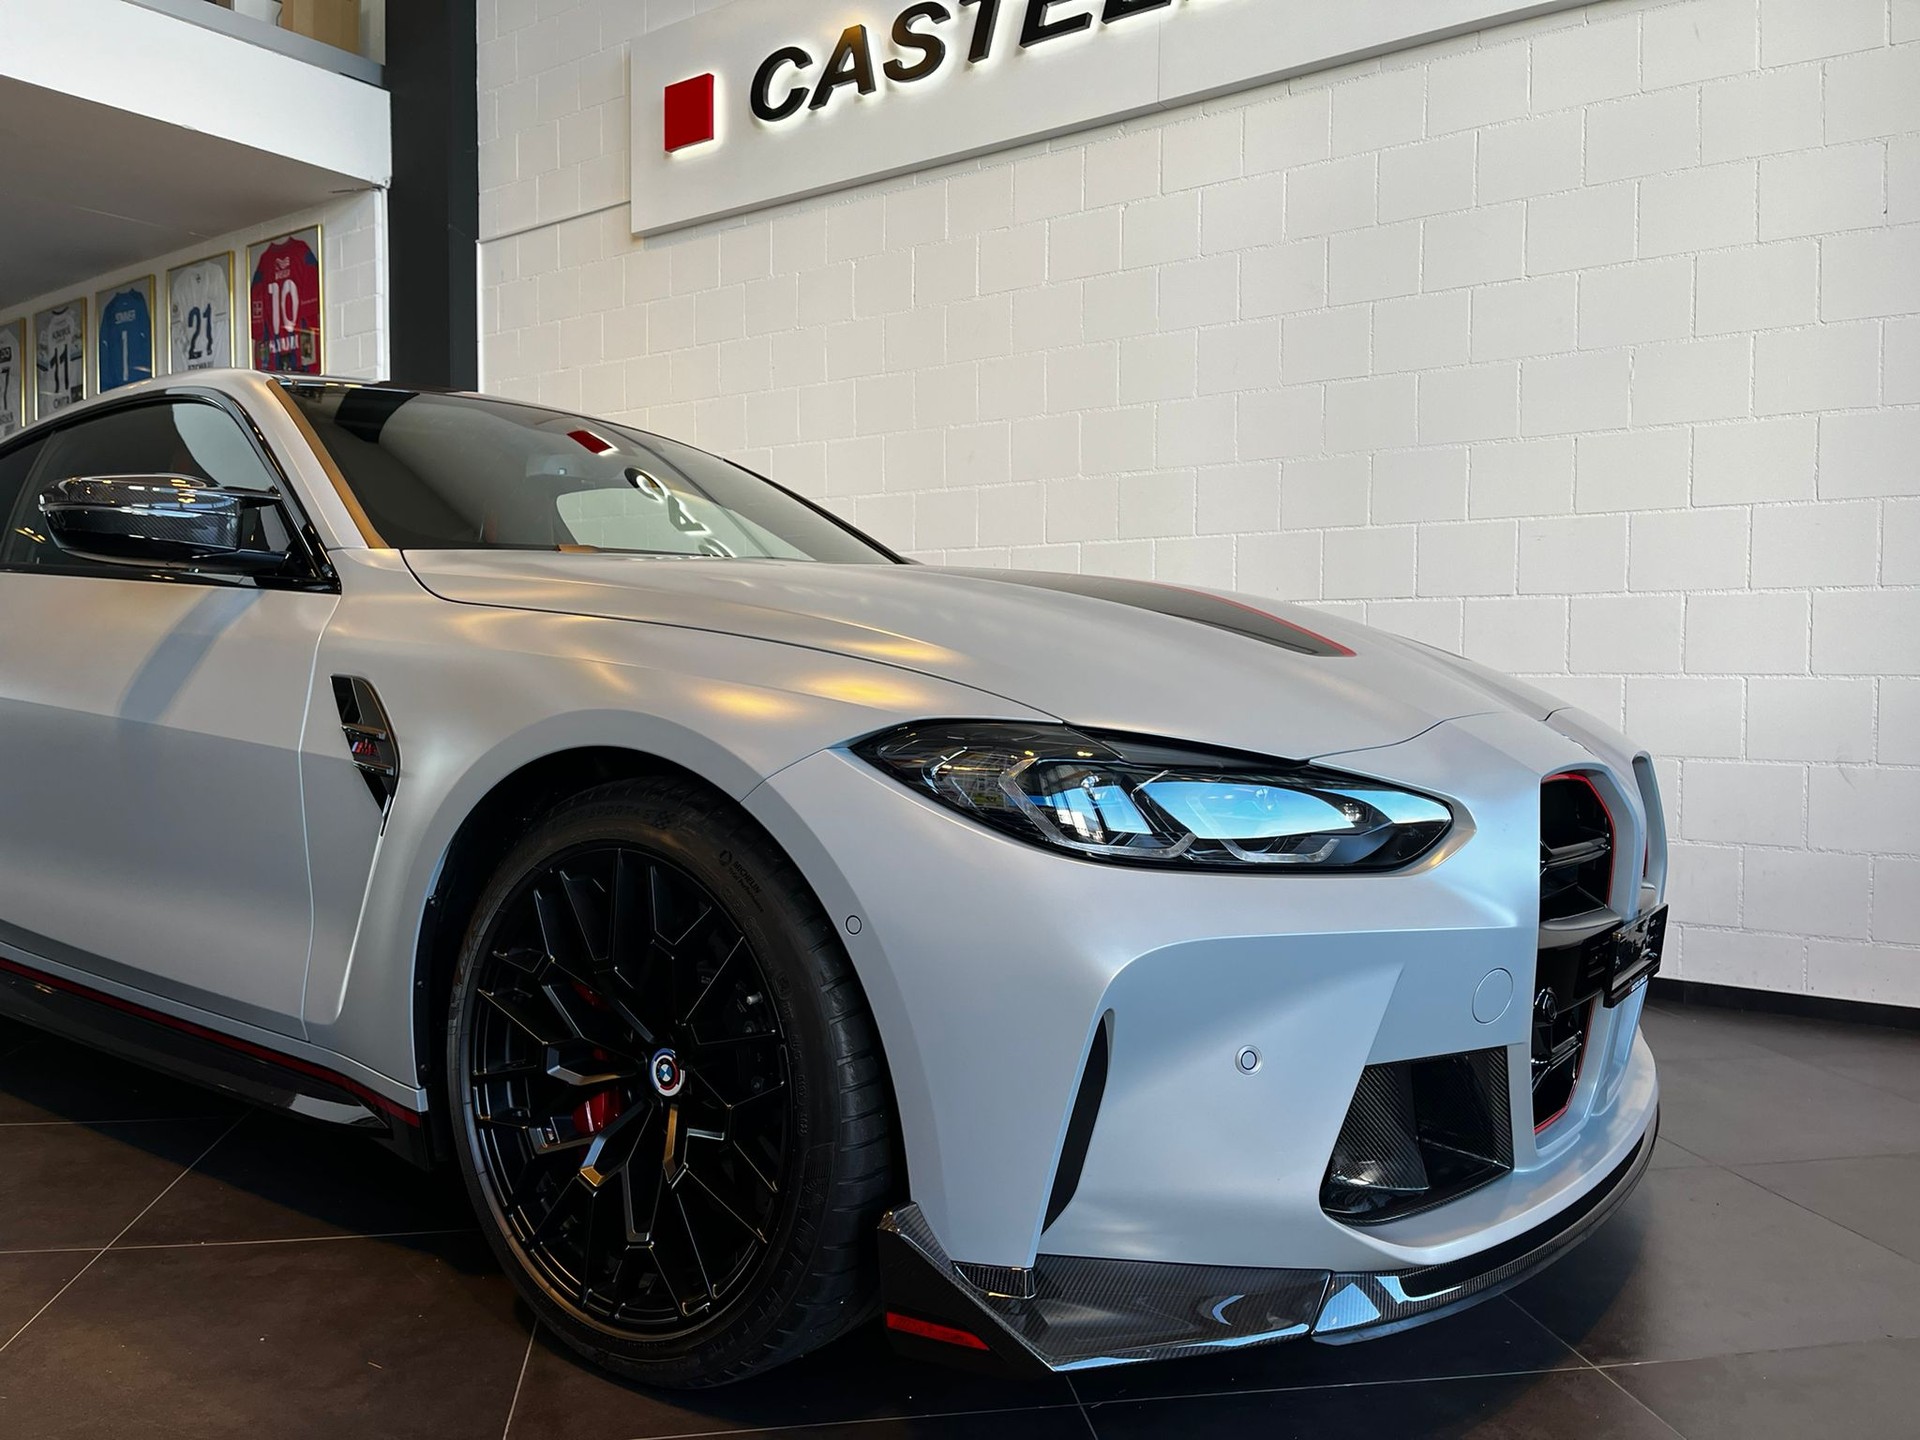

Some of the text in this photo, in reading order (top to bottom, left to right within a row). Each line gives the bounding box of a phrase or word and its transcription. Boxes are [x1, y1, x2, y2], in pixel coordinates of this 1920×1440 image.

[749, 0, 1172, 122] CASTE
[187, 303, 213, 360] 21
[267, 279, 299, 335] 10
[50, 343, 69, 393] 11
[121, 330, 129, 381] 1
